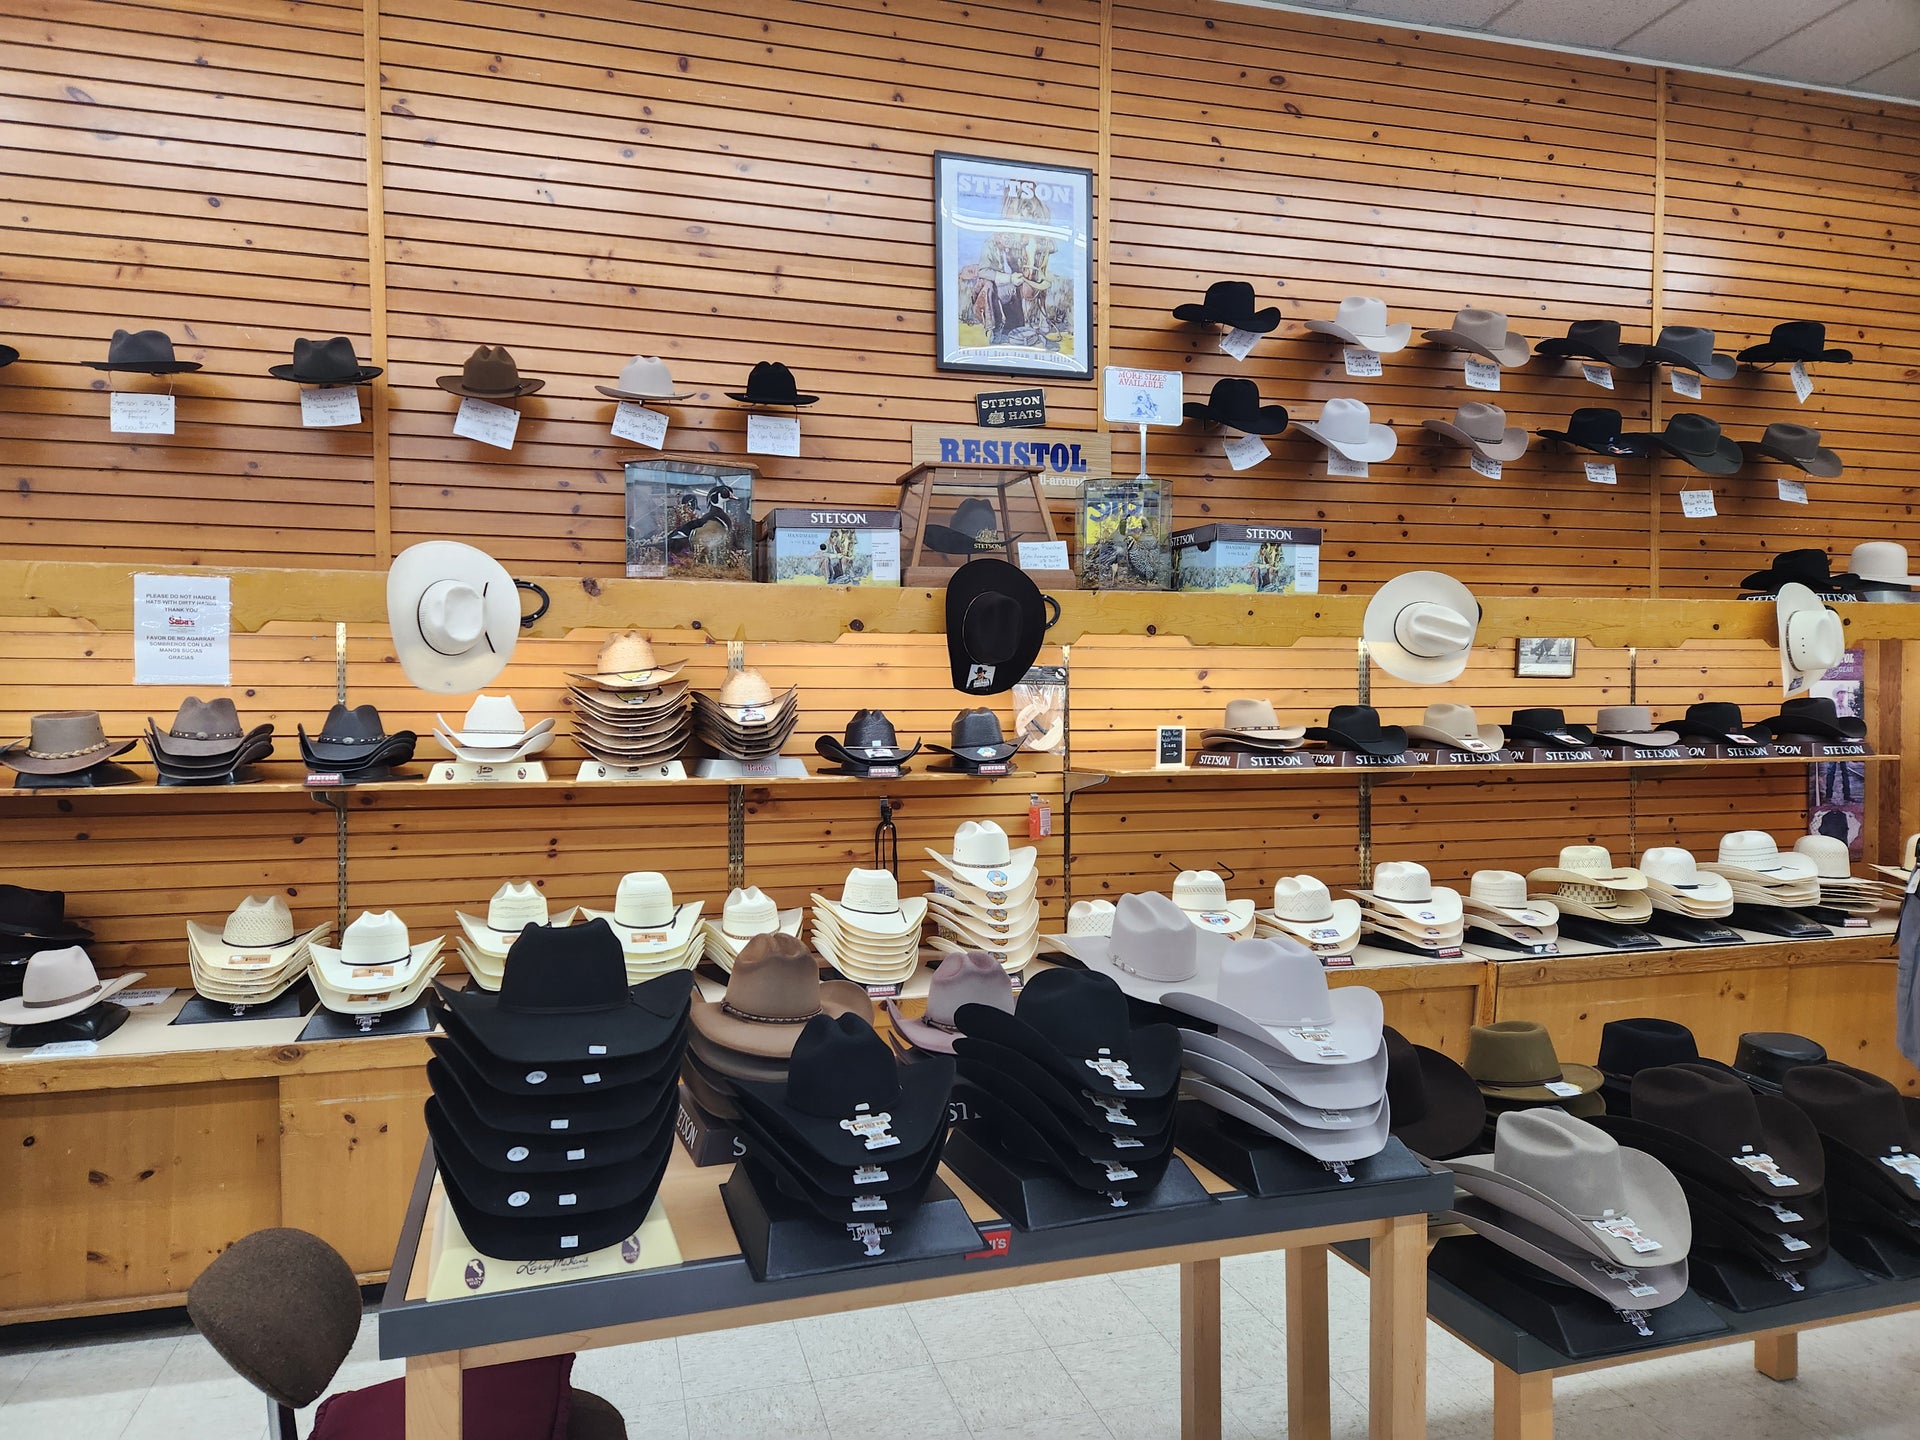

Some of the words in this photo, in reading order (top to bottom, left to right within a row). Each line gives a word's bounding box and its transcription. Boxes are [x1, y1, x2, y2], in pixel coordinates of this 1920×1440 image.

[958, 175, 1071, 203] STETSON
[1118, 371, 1143, 380] MORE
[1144, 373, 1168, 382] SIZES
[1118, 378, 1165, 389] AVAILABLE
[981, 395, 1041, 410] STETSON
[1008, 409, 1042, 420] HATS
[939, 437, 1087, 472] RESISTOL
[811, 512, 866, 524] STETSON
[1170, 533, 1195, 547] STETSON
[1246, 528, 1293, 541] STETSON
[1635, 748, 1681, 759] STETSON
[1728, 746, 1768, 757] STETSON
[1774, 745, 1802, 755] TSON
[1823, 745, 1865, 755] STETSON
[1199, 754, 1230, 766] STETSON
[1250, 755, 1302, 767] STETSON
[1355, 754, 1407, 765] STETSON
[1450, 752, 1502, 763] STETSON
[1546, 751, 1593, 761] STETSON
[677, 1104, 698, 1150] ETSON
